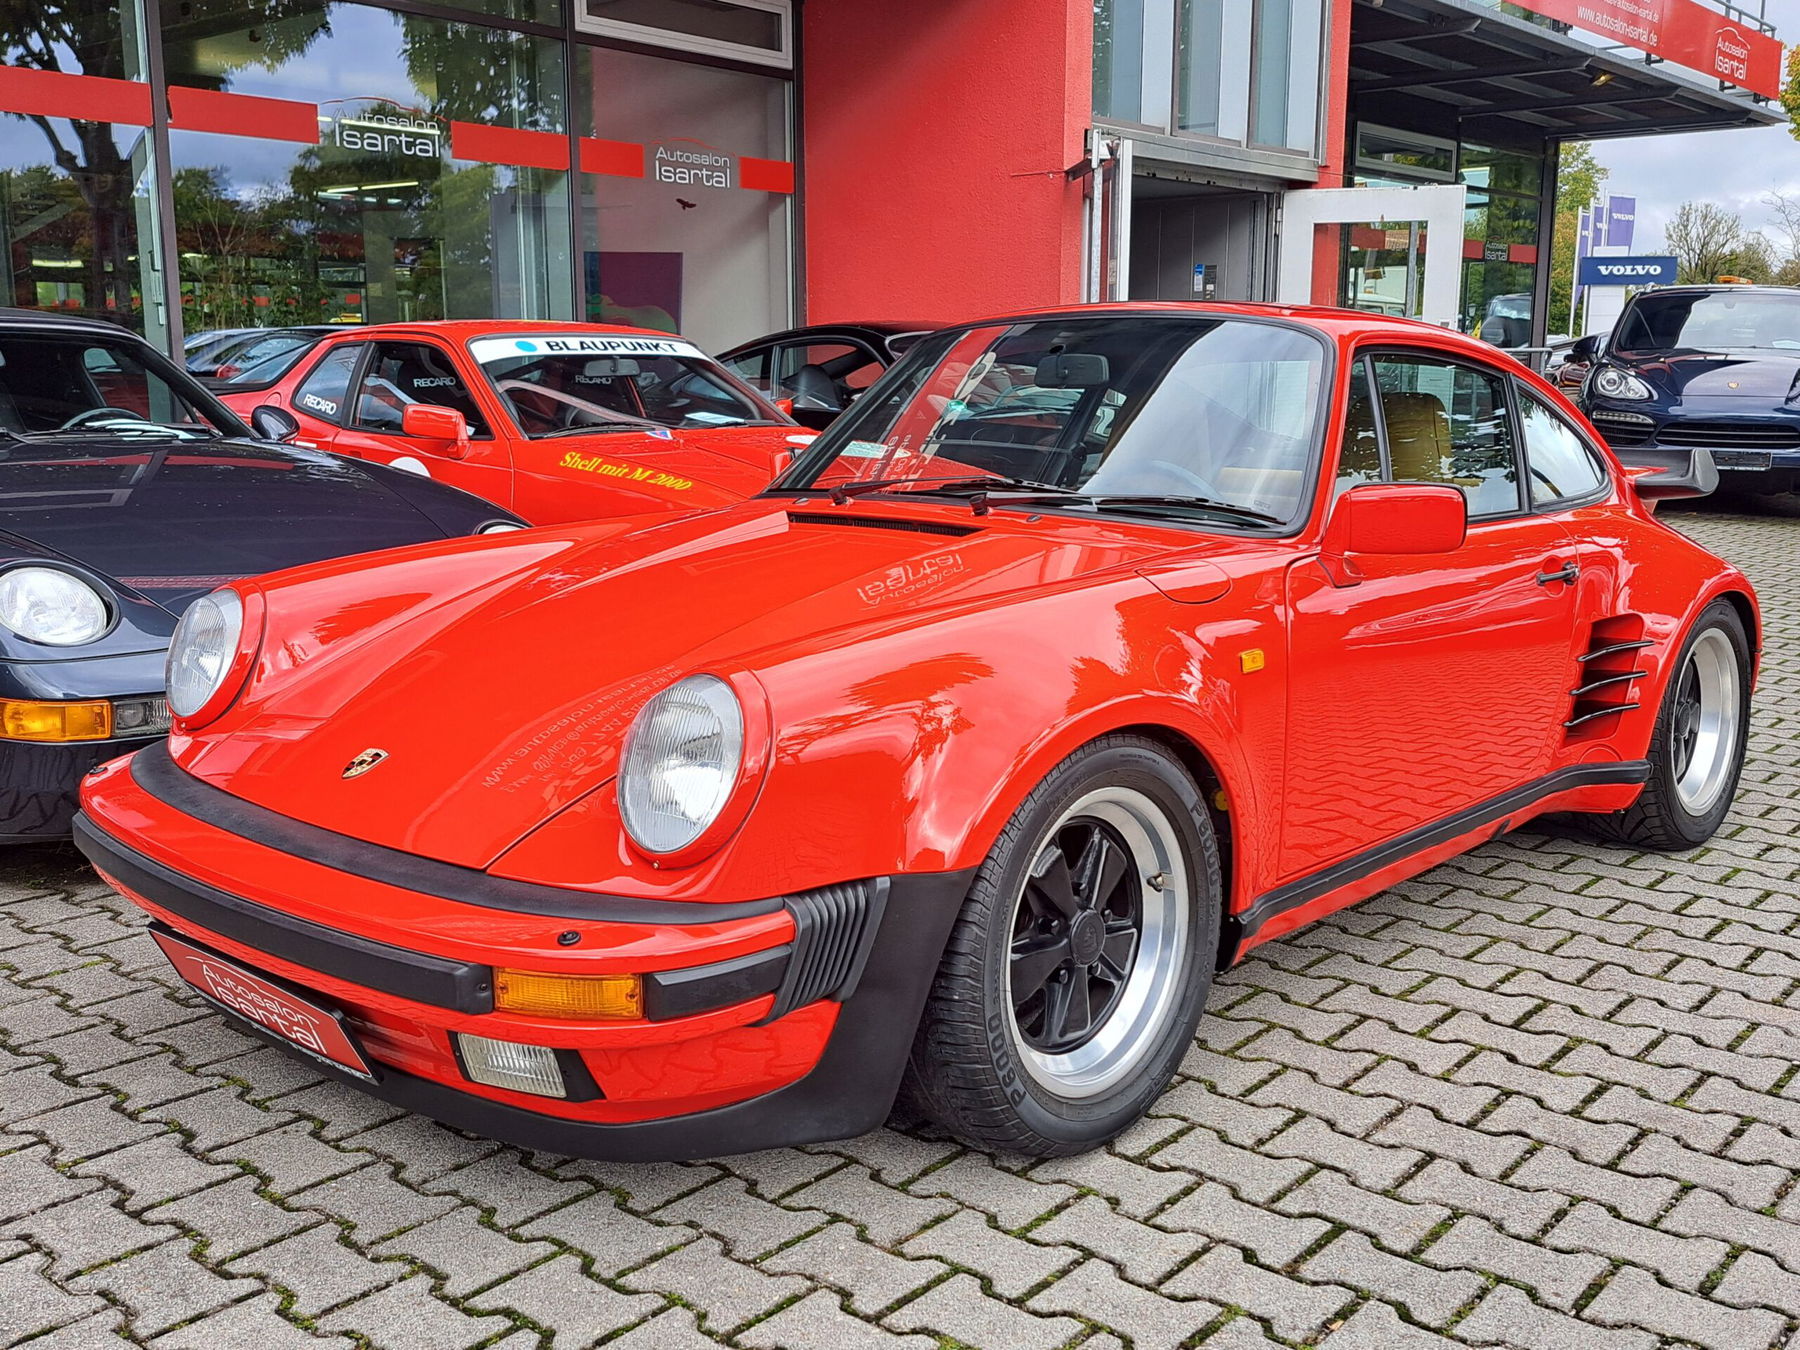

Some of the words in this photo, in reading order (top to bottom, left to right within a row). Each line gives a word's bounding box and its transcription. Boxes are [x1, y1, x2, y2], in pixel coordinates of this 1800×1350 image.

[1577, 5, 1658, 47] www.autosalon-isartal.de
[1716, 36, 1748, 60] Autosalon
[1714, 48, 1747, 81] Isartal
[335, 122, 440, 158] Isartal
[655, 146, 730, 168] Autosalon
[655, 160, 731, 189] Isartal
[1612, 212, 1635, 221] VOLVO
[1597, 265, 1662, 276] VOLVO
[544, 340, 679, 353] BLAUPUNKT
[413, 376, 456, 388] RECARO
[303, 393, 337, 415] RECARO
[559, 451, 602, 473] Shell
[596, 463, 629, 478] mit
[625, 467, 654, 482] M
[646, 473, 693, 491] 2000
[202, 963, 314, 1030] Autosalon
[204, 974, 328, 1056] Isartal
[988, 1010, 1027, 1108] P6000
